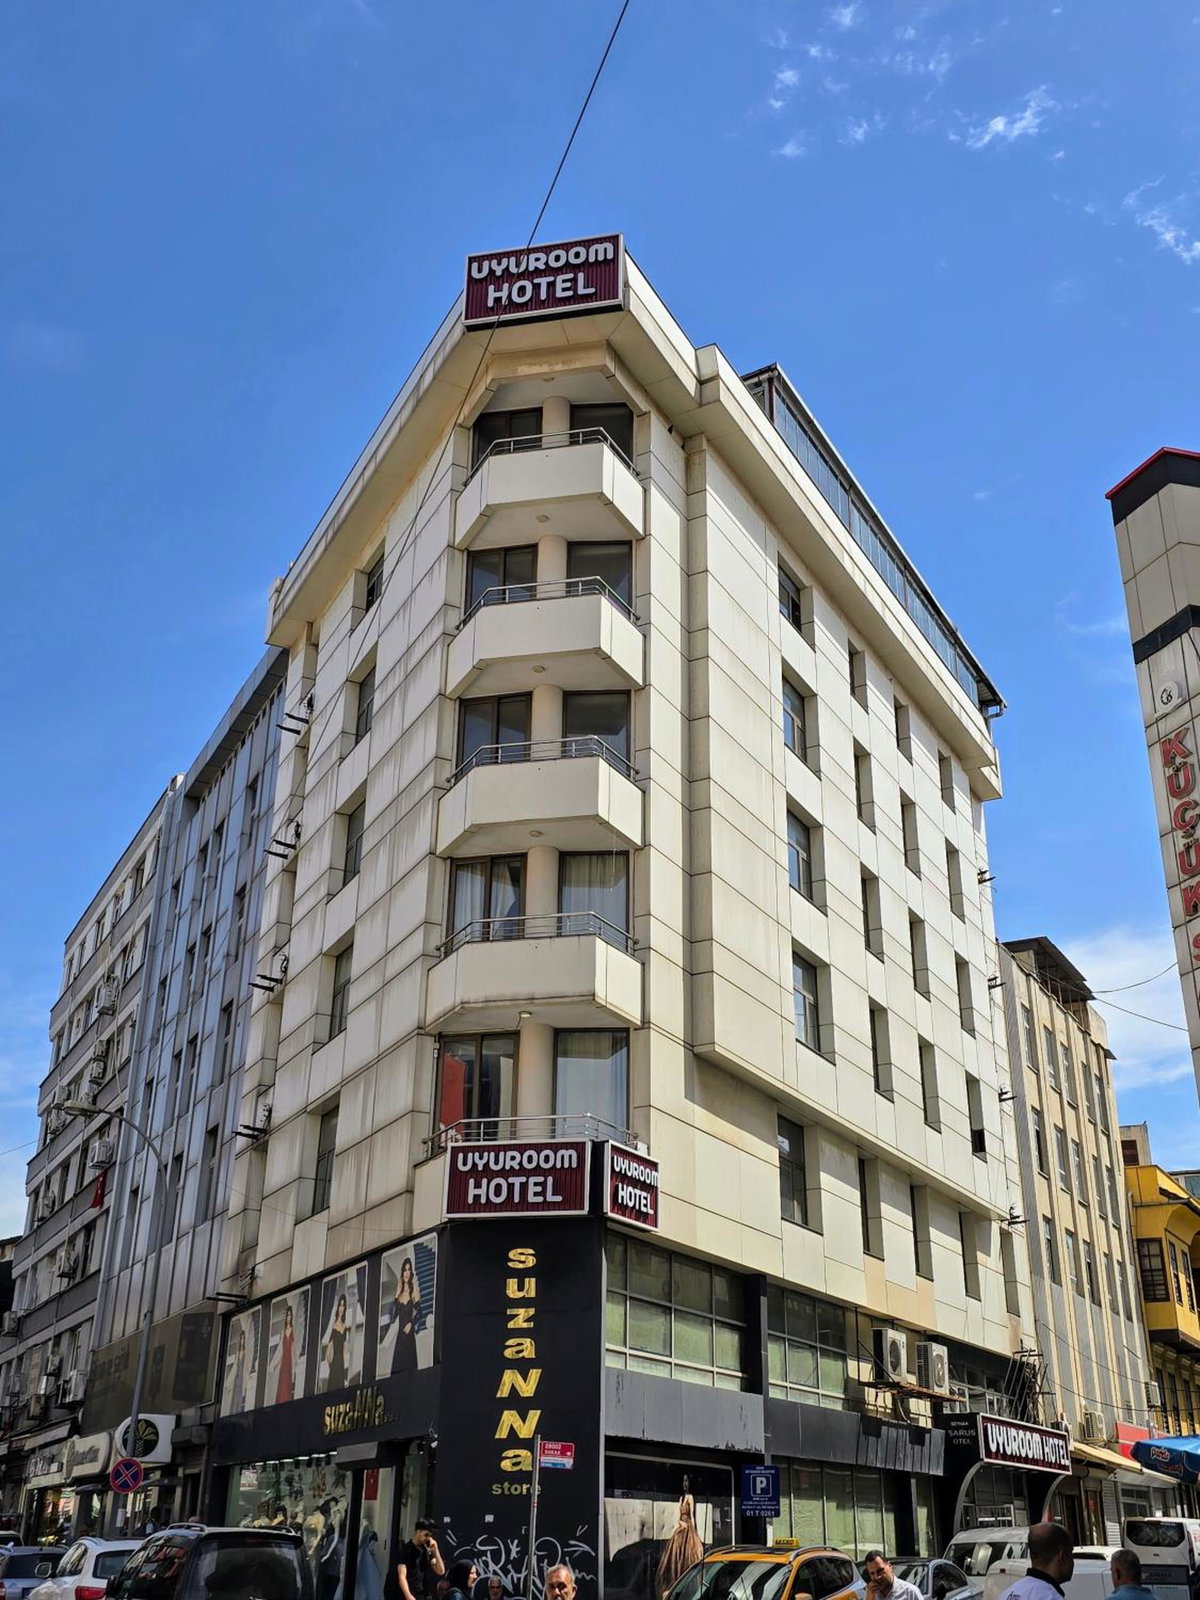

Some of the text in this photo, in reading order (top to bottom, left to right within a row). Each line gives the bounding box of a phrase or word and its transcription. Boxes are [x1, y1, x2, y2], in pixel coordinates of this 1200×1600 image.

[471, 242, 614, 279] UYUROOM
[487, 272, 596, 308] HOTEL
[457, 1149, 577, 1172] UYUROOM
[614, 1155, 658, 1187] UYUROOM
[467, 1176, 563, 1205] HOTEL
[617, 1182, 654, 1215] HOTEL
[948, 1429, 976, 1437] SARUS
[987, 1423, 1071, 1466] UYUROOM HOTEL
